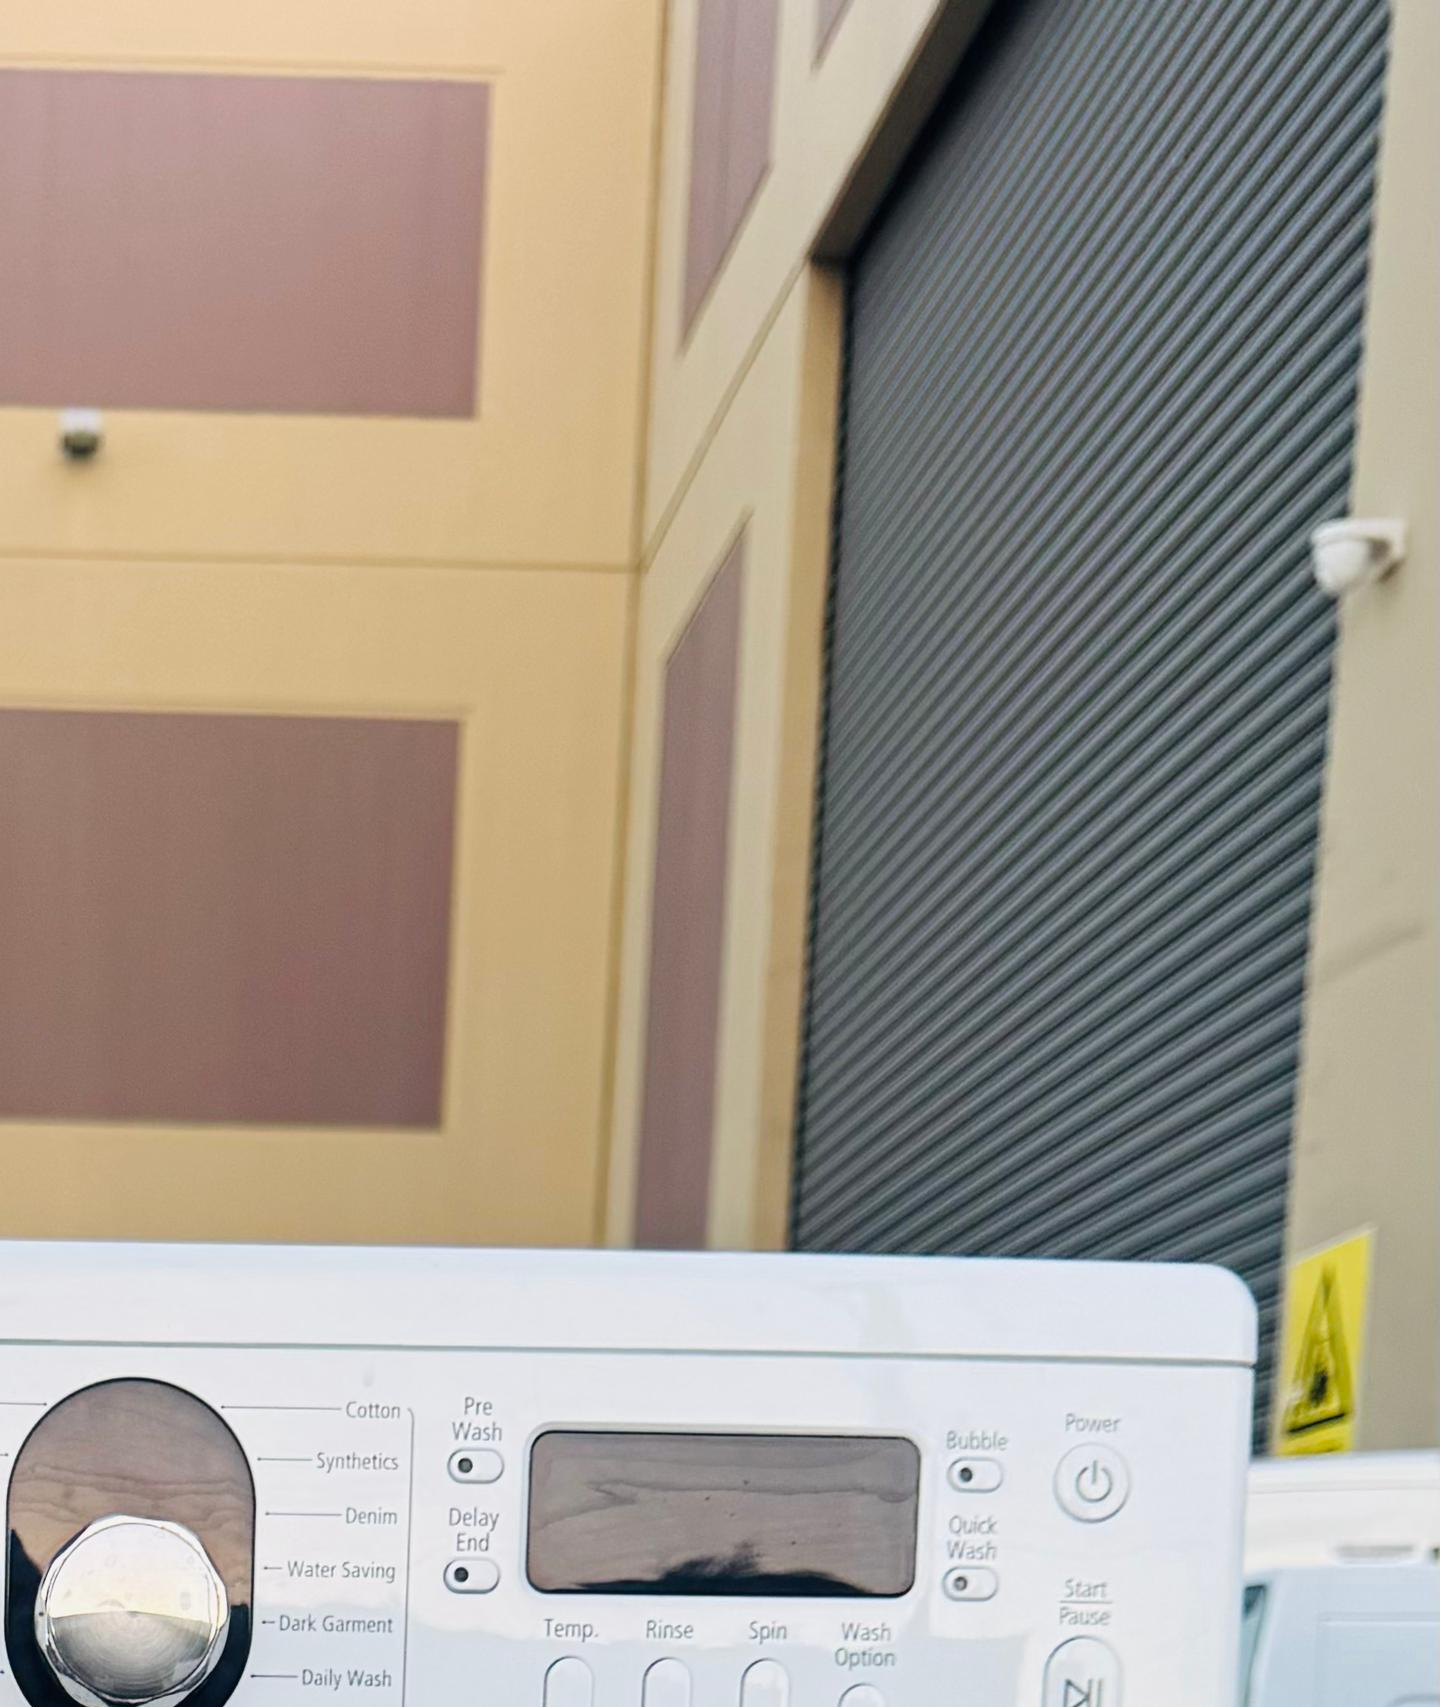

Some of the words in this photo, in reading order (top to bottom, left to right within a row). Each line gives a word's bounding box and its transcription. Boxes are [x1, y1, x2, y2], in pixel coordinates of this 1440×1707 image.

[346, 1401, 400, 1418] Cotton
[464, 1397, 492, 1416] Pre
[452, 1422, 502, 1441] Wash
[1066, 1413, 1121, 1433] Power
[946, 1430, 1008, 1451] Bubble
[317, 1452, 398, 1473] Synthetics
[346, 1507, 397, 1524] Denim
[449, 1507, 499, 1531] Delay
[949, 1515, 997, 1536] Quick
[457, 1531, 489, 1551] End
[947, 1541, 997, 1560] Wash
[288, 1561, 336, 1578] Water
[342, 1562, 395, 1583] Saving
[1065, 1579, 1107, 1599] Start
[280, 1614, 316, 1631] Dark
[322, 1615, 392, 1633] Garment
[1060, 1606, 1111, 1626] Pause
[544, 1619, 598, 1643] Temp.
[646, 1620, 693, 1639] Rinse
[749, 1621, 787, 1645] Spin
[842, 1623, 891, 1641] Wash
[835, 1648, 895, 1670] Option
[302, 1669, 341, 1690] Daily
[349, 1670, 391, 1687] Wash
